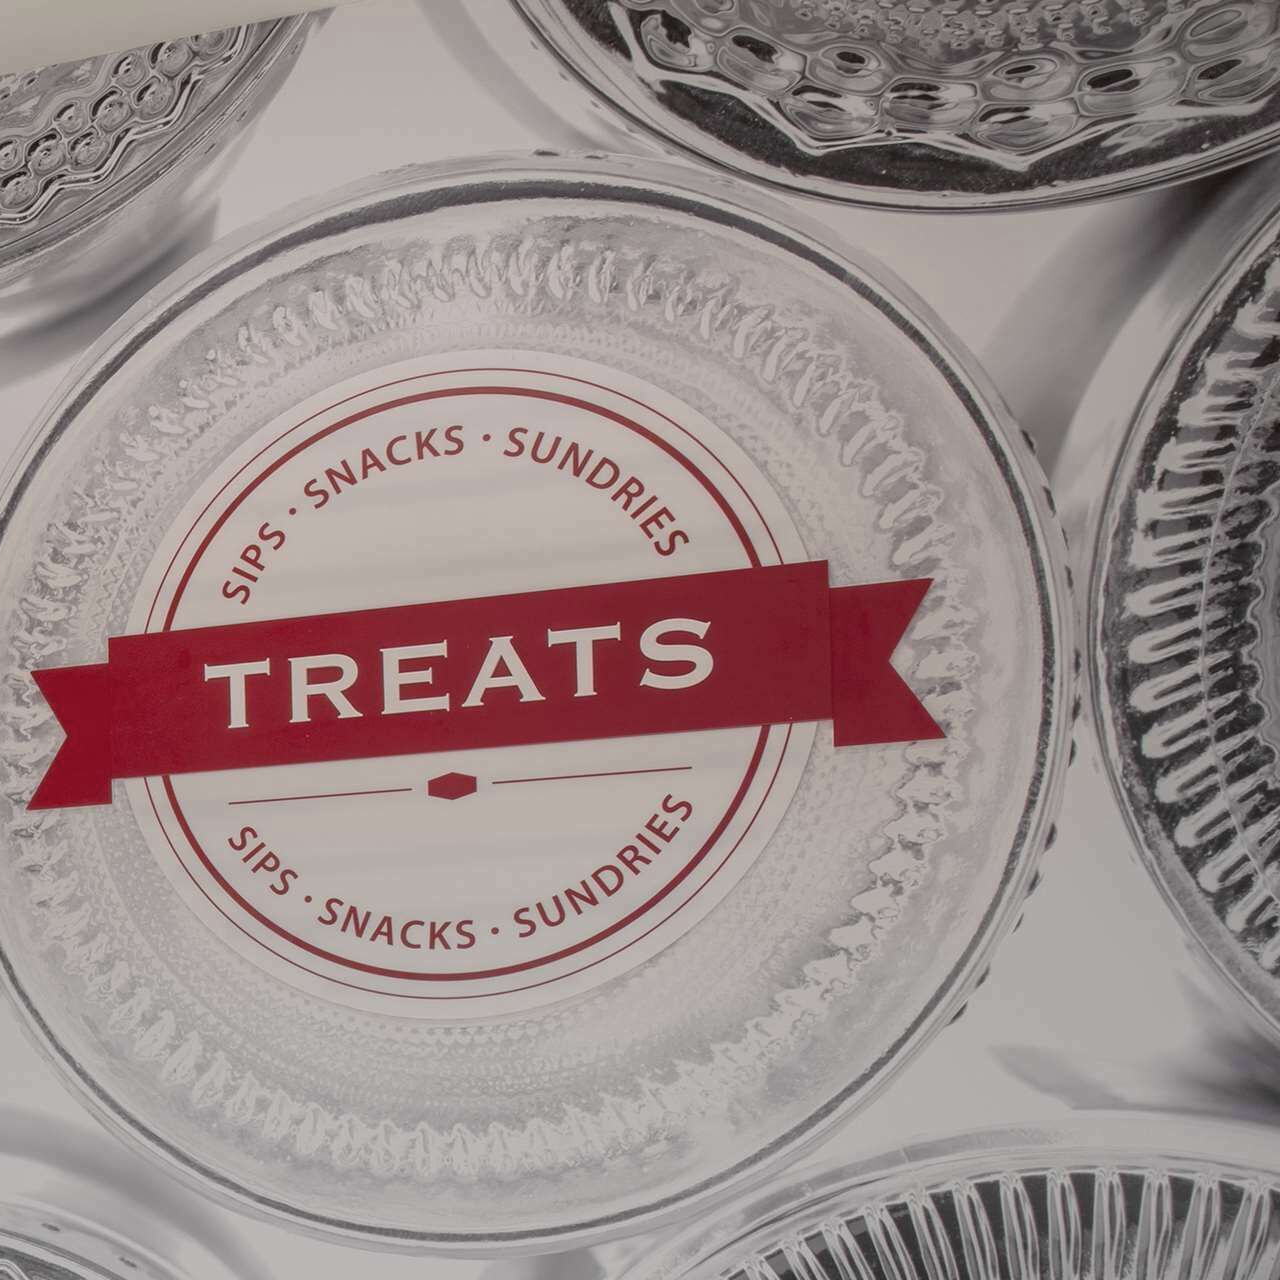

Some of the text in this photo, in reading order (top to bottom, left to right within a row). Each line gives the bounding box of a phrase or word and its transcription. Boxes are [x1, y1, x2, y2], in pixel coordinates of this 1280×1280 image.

[222, 424, 691, 606] SIPS SNACKS SUNDRIES
[204, 617, 715, 729] TREATS
[228, 793, 694, 951] SIPS SNACKS SUNDRIES
